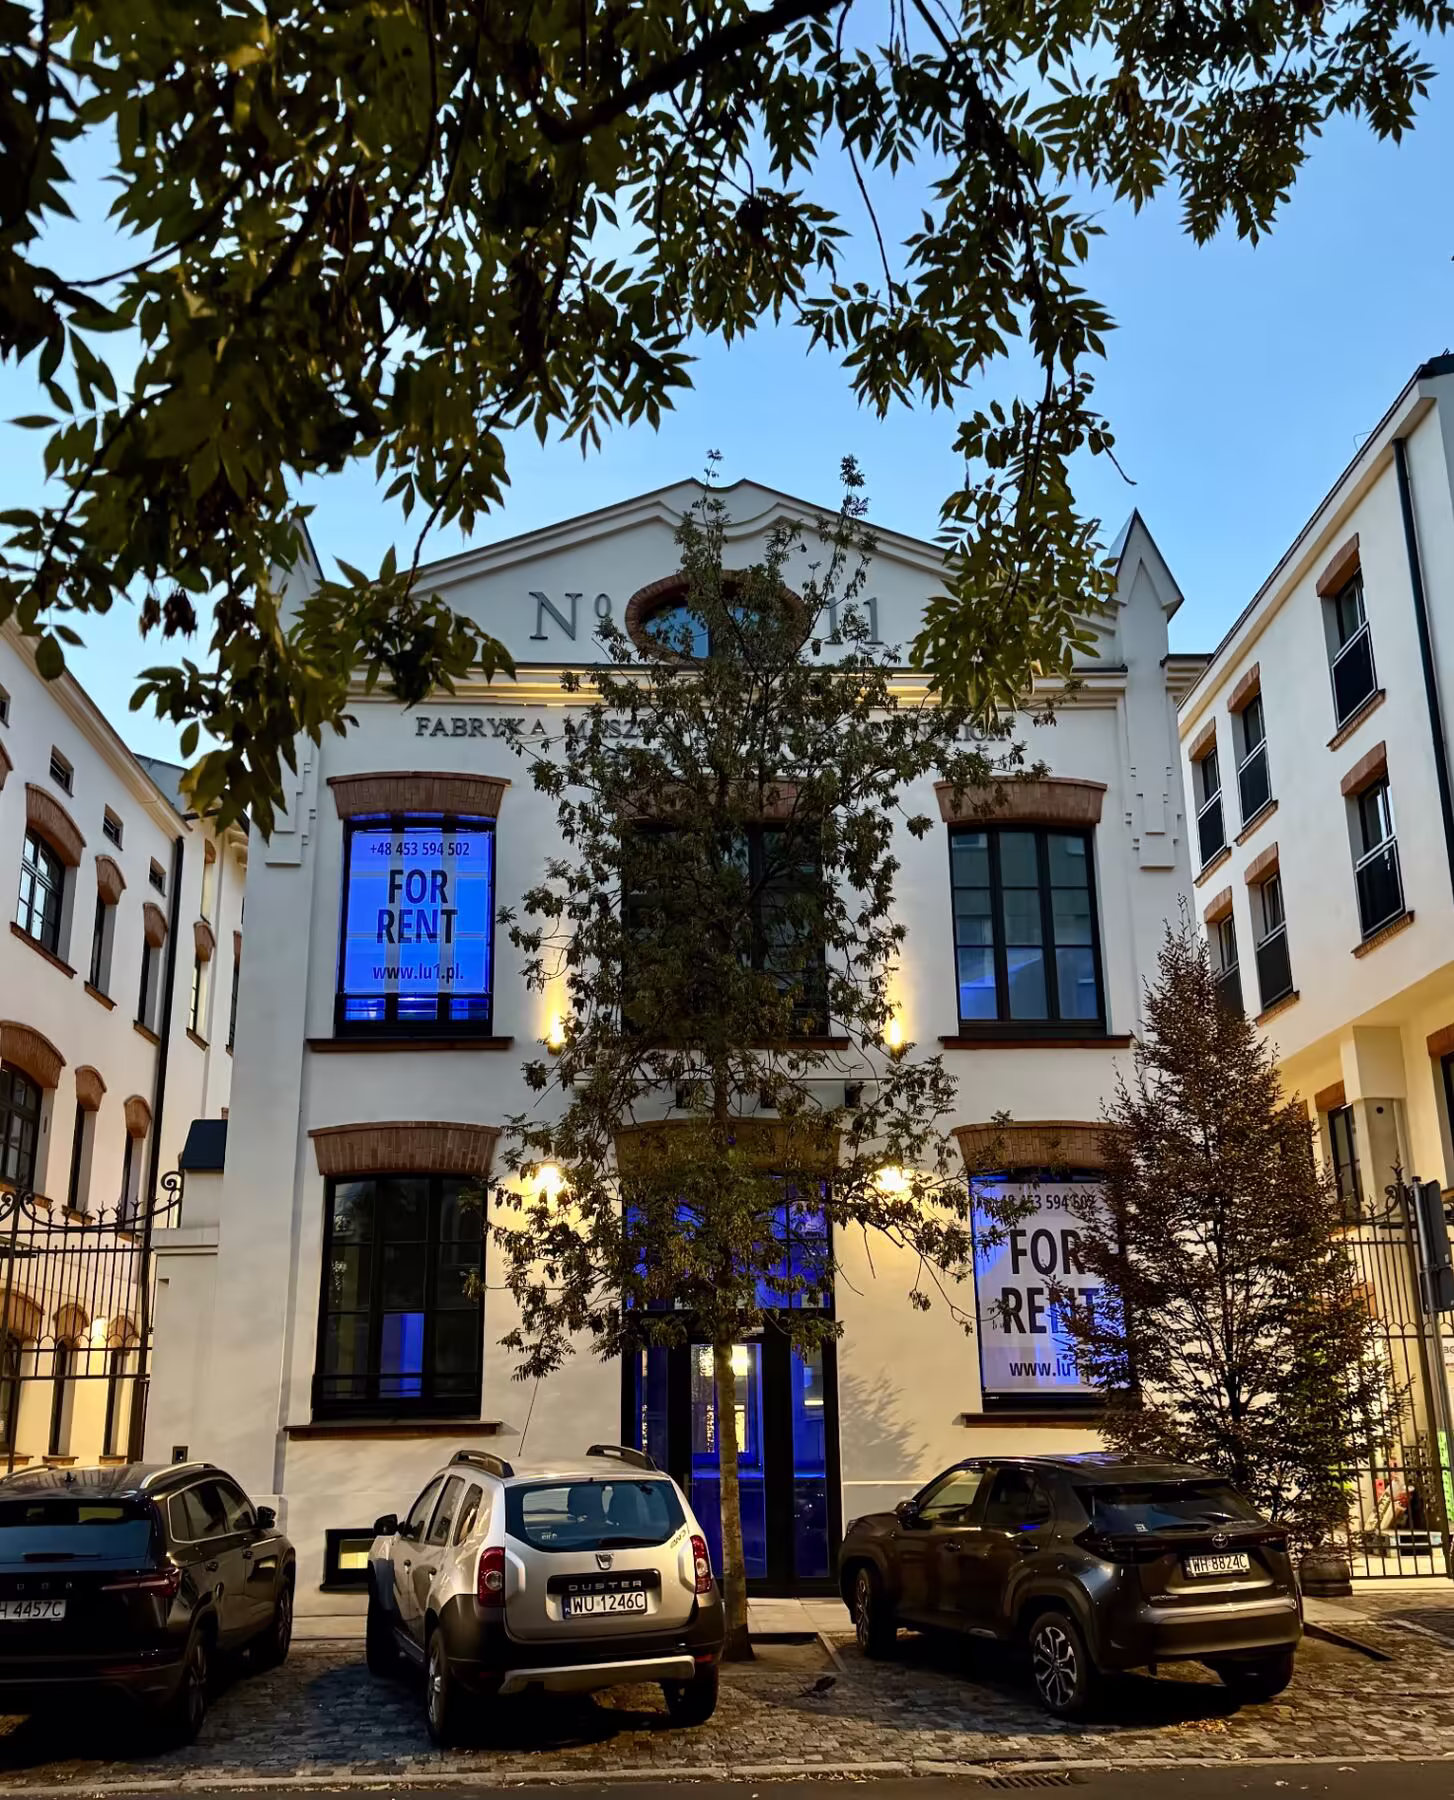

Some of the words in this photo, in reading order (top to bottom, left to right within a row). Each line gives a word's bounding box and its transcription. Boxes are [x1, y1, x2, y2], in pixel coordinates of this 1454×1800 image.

[415, 716, 547, 737] FABRYKA
[370, 842, 392, 856] +48
[395, 842, 418, 856] 453
[422, 842, 444, 856] 594
[447, 842, 470, 856] 502
[388, 869, 449, 905] FOR
[376, 908, 459, 944] RENT
[1046, 1194, 1068, 1210] 594
[1009, 1228, 1086, 1275] FOR
[1191, 1556, 1210, 1572] WH
[1213, 1553, 1248, 1571] 8824C
[568, 1579, 643, 1592] DUSTER
[13, 1600, 63, 1618] 4457C
[572, 1595, 595, 1614] WU
[601, 1592, 644, 1612] 1246C
